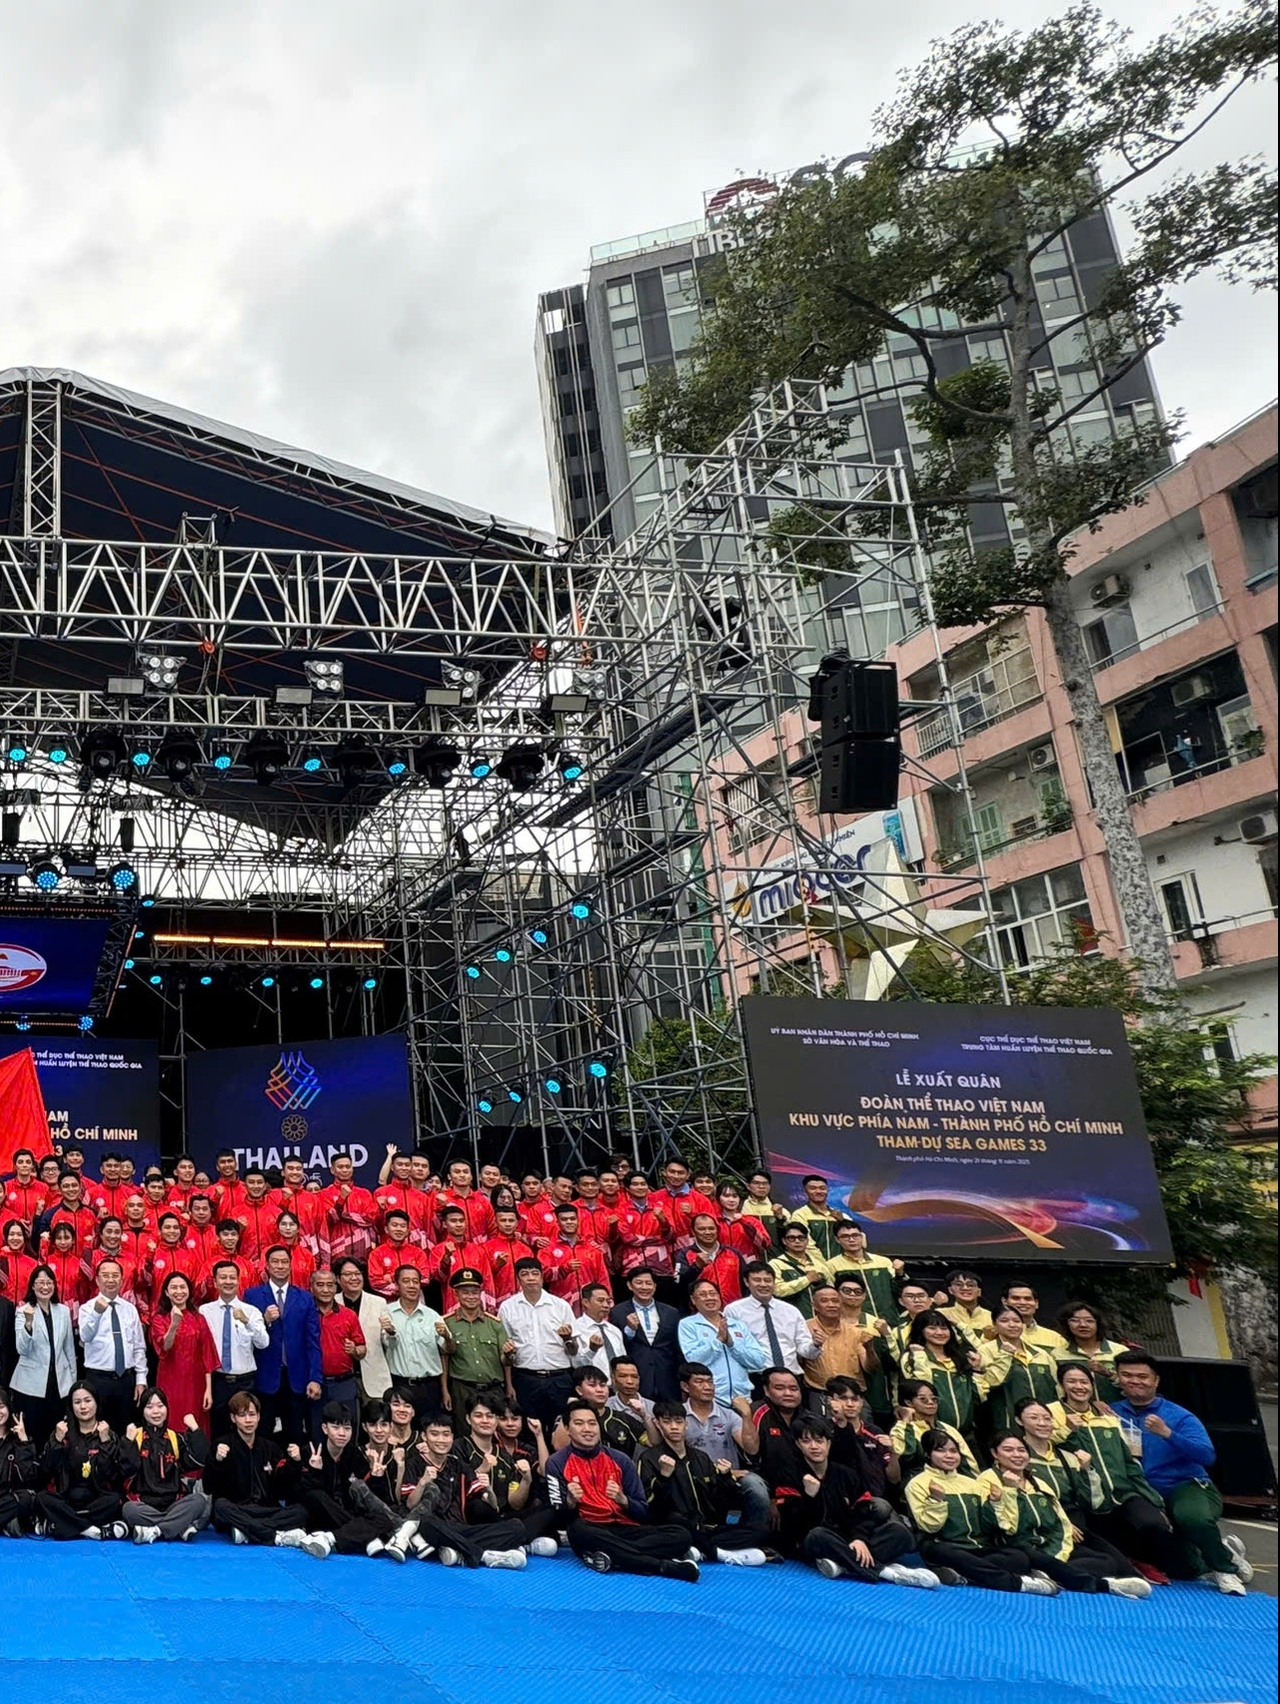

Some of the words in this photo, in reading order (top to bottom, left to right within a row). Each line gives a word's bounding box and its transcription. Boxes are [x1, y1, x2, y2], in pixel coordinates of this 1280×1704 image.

[895, 1069, 911, 1086] LỄ
[915, 1071, 953, 1087] XUẤT
[958, 1074, 1001, 1089] QUÂN
[860, 1094, 904, 1109] ĐOÀN
[907, 1092, 933, 1111] THỂ
[935, 1099, 975, 1112] THAO
[979, 1097, 1008, 1116] VIỆT
[1011, 1101, 1046, 1114] NAM
[45, 1111, 68, 1122] AM
[789, 1113, 820, 1126] KHU
[822, 1114, 855, 1130] VỰC
[858, 1113, 893, 1128] PHÍA
[896, 1117, 930, 1130] NAM
[941, 1116, 990, 1131] THÀNH
[994, 1115, 1025, 1132] PHỐ
[1028, 1115, 1051, 1133] HỒ
[1055, 1118, 1082, 1134] CHÍ
[1084, 1122, 1123, 1134] MINH
[51, 1123, 71, 1139] HỒ
[75, 1126, 99, 1139] CHÍ
[103, 1129, 138, 1140] MINH
[946, 1137, 973, 1150] SEA
[975, 1138, 1026, 1151] GAMES
[1029, 1140, 1047, 1151] 33
